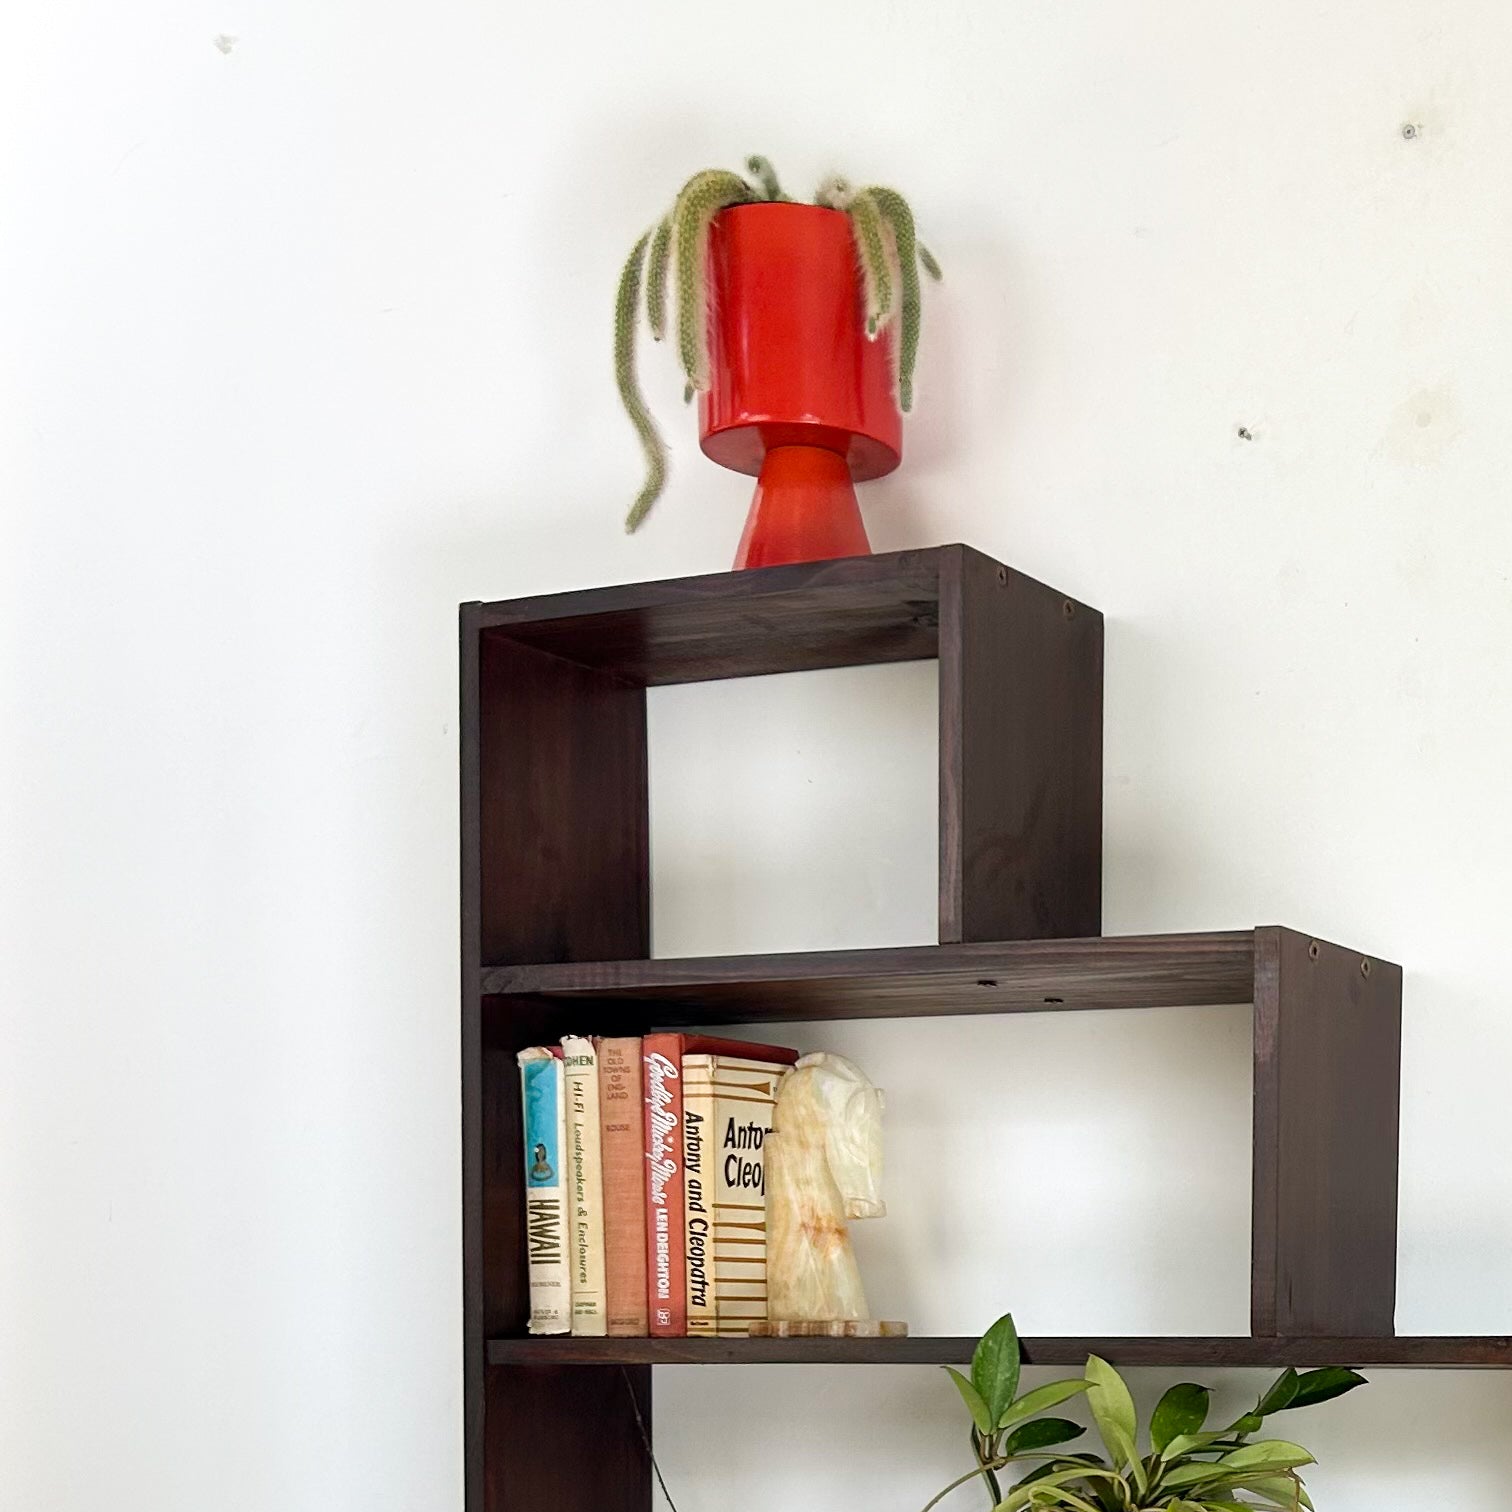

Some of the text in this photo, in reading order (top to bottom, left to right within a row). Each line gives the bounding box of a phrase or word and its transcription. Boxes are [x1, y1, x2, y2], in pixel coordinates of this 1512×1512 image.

[685, 1110, 704, 1174] Antony
[573, 1081, 589, 1284] HI-FI Loudspeakers & Enclosures
[687, 1179, 707, 1213] and
[529, 1199, 561, 1265] HAWAII
[655, 1207, 669, 1232] LEN
[656, 1232, 670, 1299] DEIGHTON
[687, 1218, 710, 1307] Cleopatra
